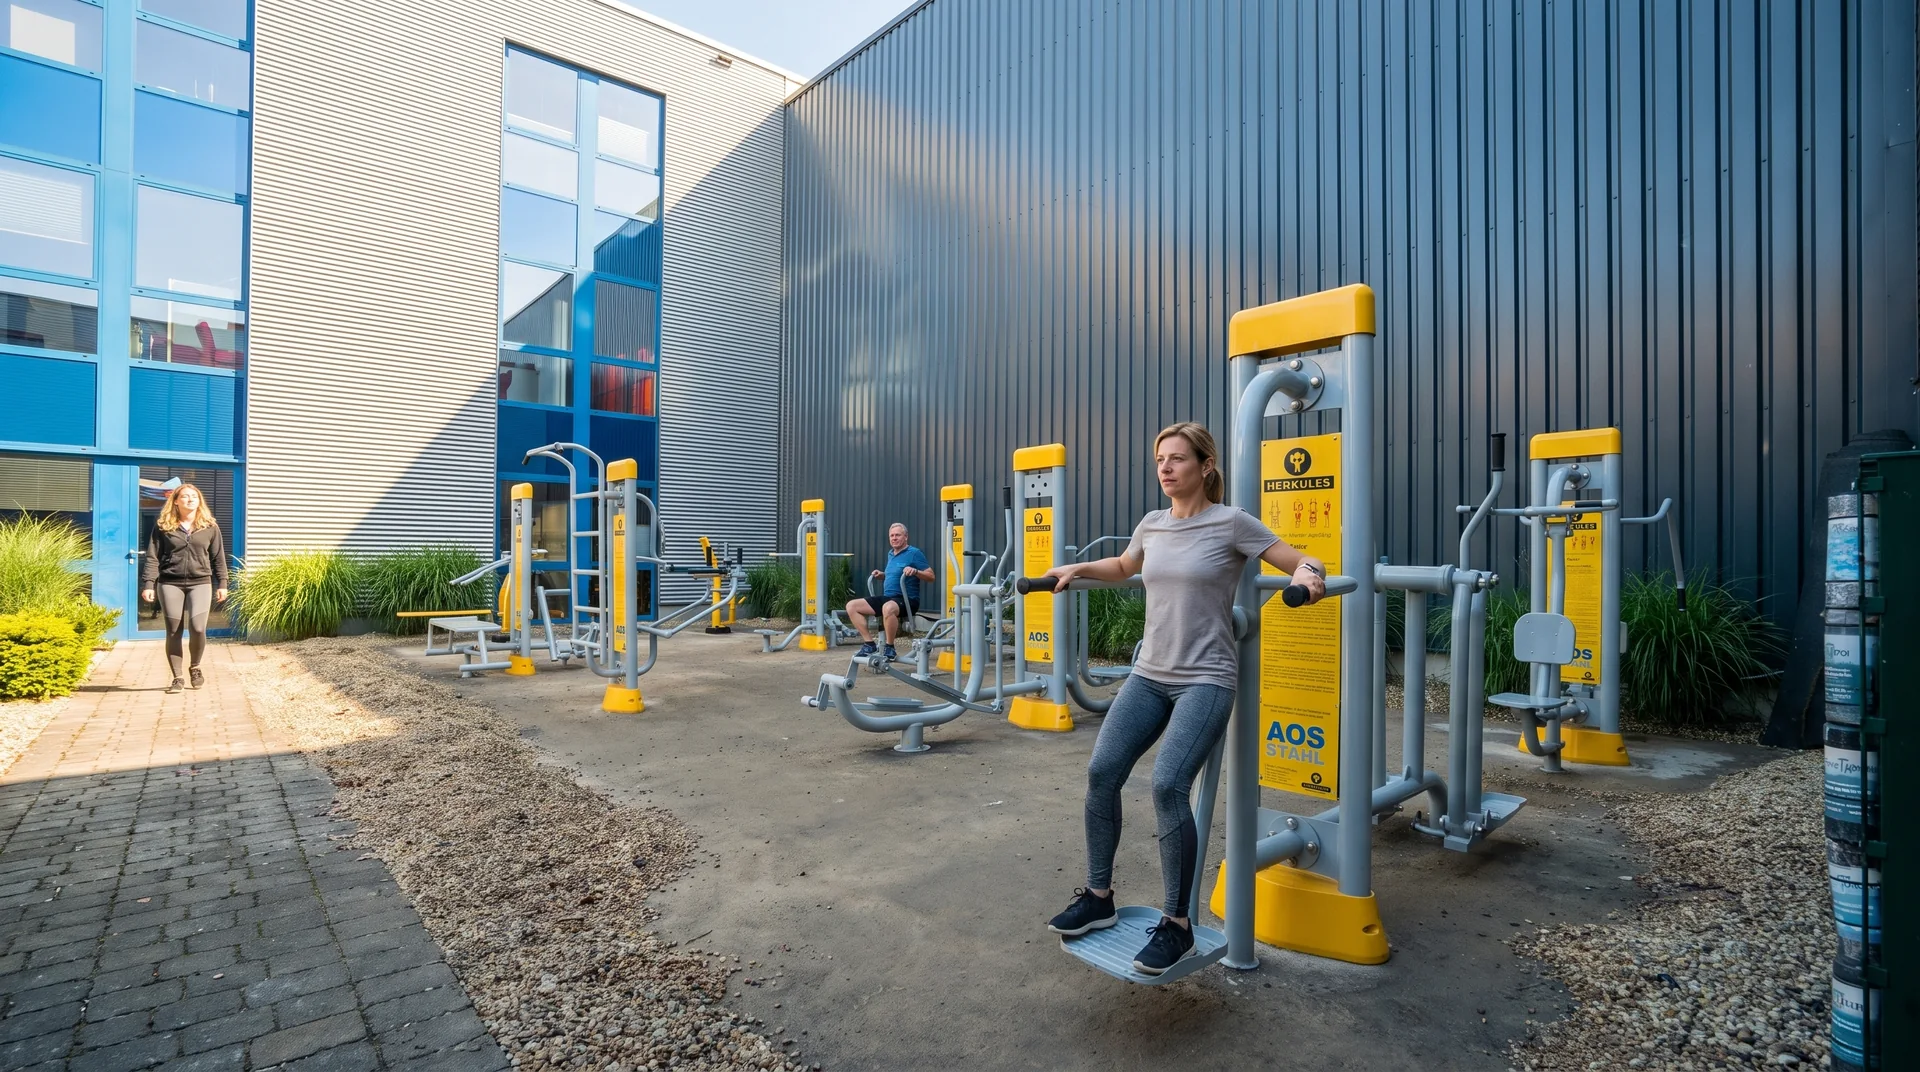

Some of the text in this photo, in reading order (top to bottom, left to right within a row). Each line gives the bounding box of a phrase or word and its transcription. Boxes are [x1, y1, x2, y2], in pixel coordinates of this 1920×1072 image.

[1267, 478, 1331, 491] HERKULES
[1028, 631, 1050, 643] AOS
[1573, 647, 1593, 660] OS
[1266, 720, 1325, 750] AOS
[1266, 743, 1325, 766] STAHL
